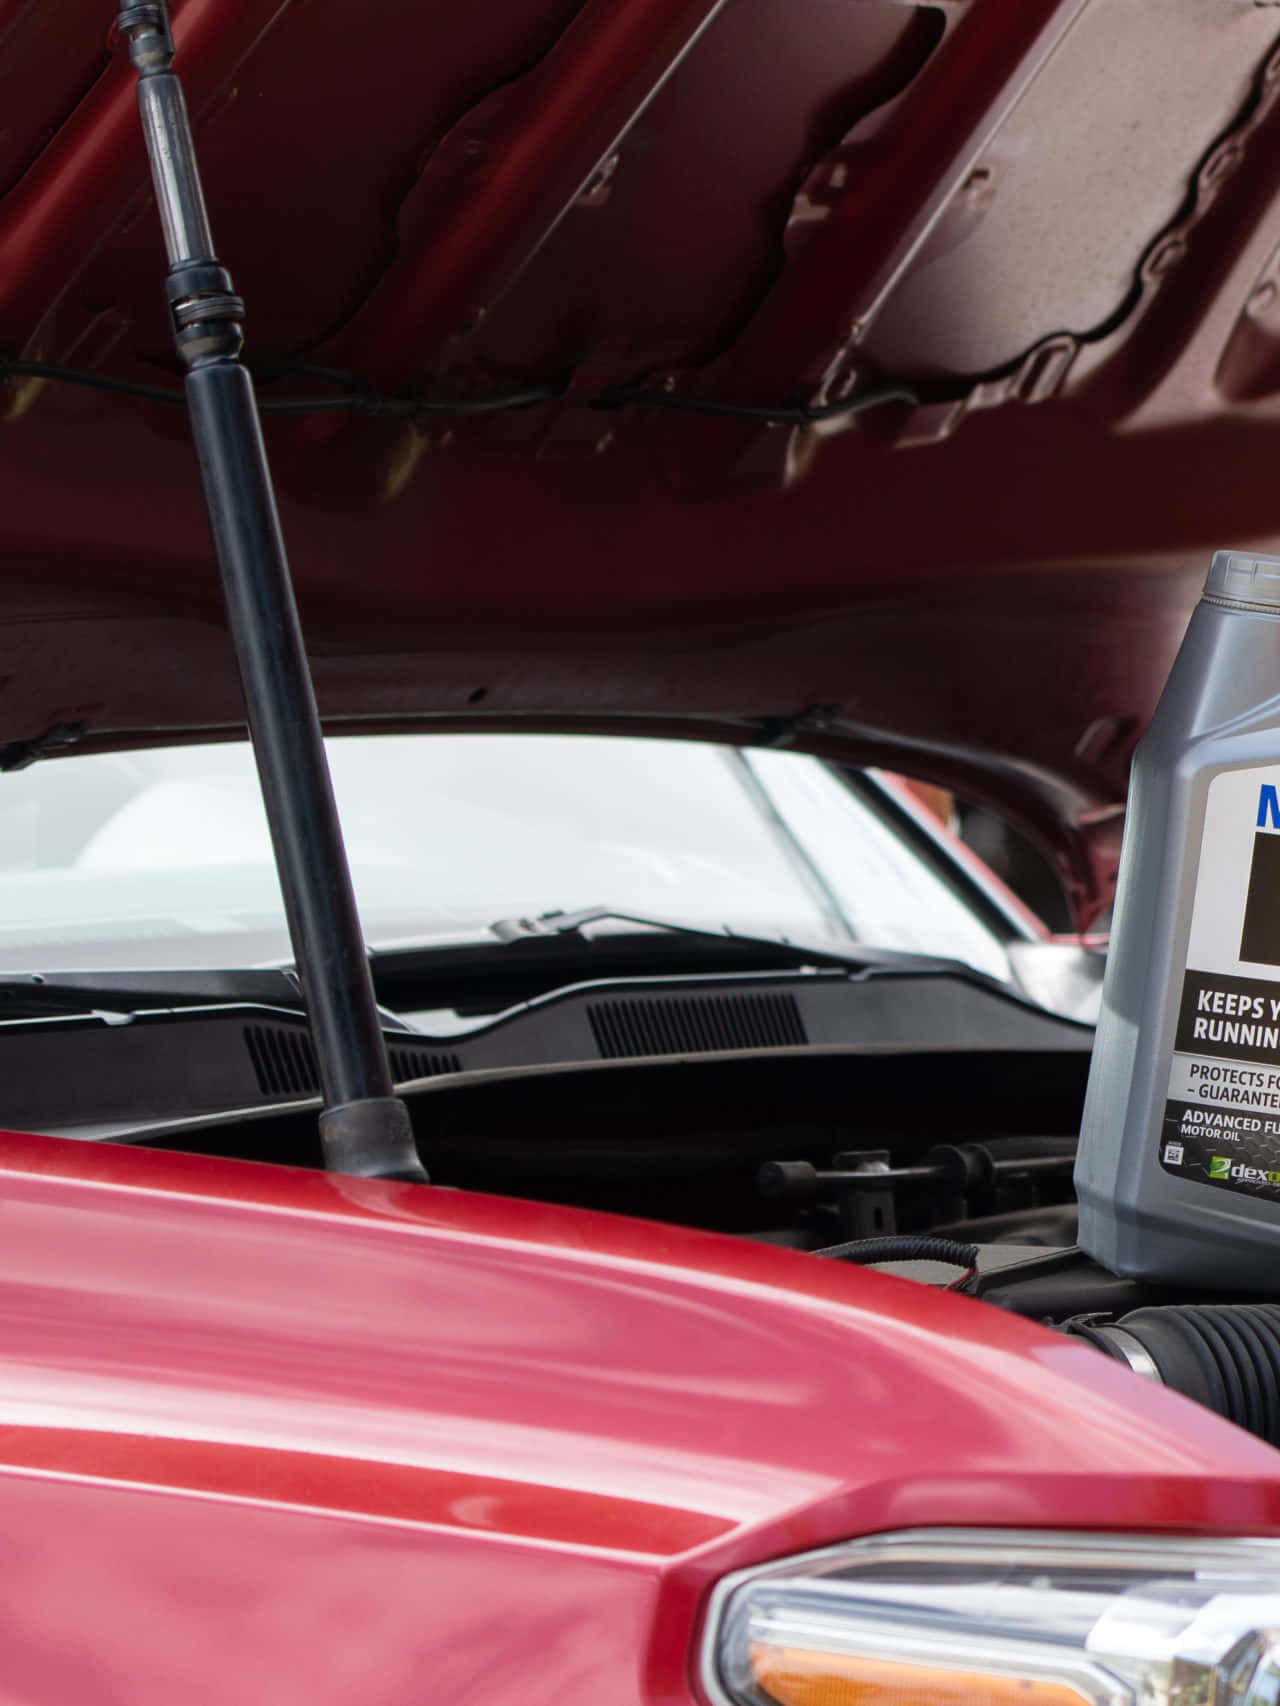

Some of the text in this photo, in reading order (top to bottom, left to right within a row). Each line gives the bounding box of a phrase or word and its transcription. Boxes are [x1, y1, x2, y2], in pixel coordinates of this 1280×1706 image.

[1198, 989, 1264, 1019] KEEPS
[1189, 1063, 1265, 1087] PROTECTS
[1182, 1110, 1262, 1132] ADVANCED
[1180, 1124, 1241, 1142] MOTOR OIL
